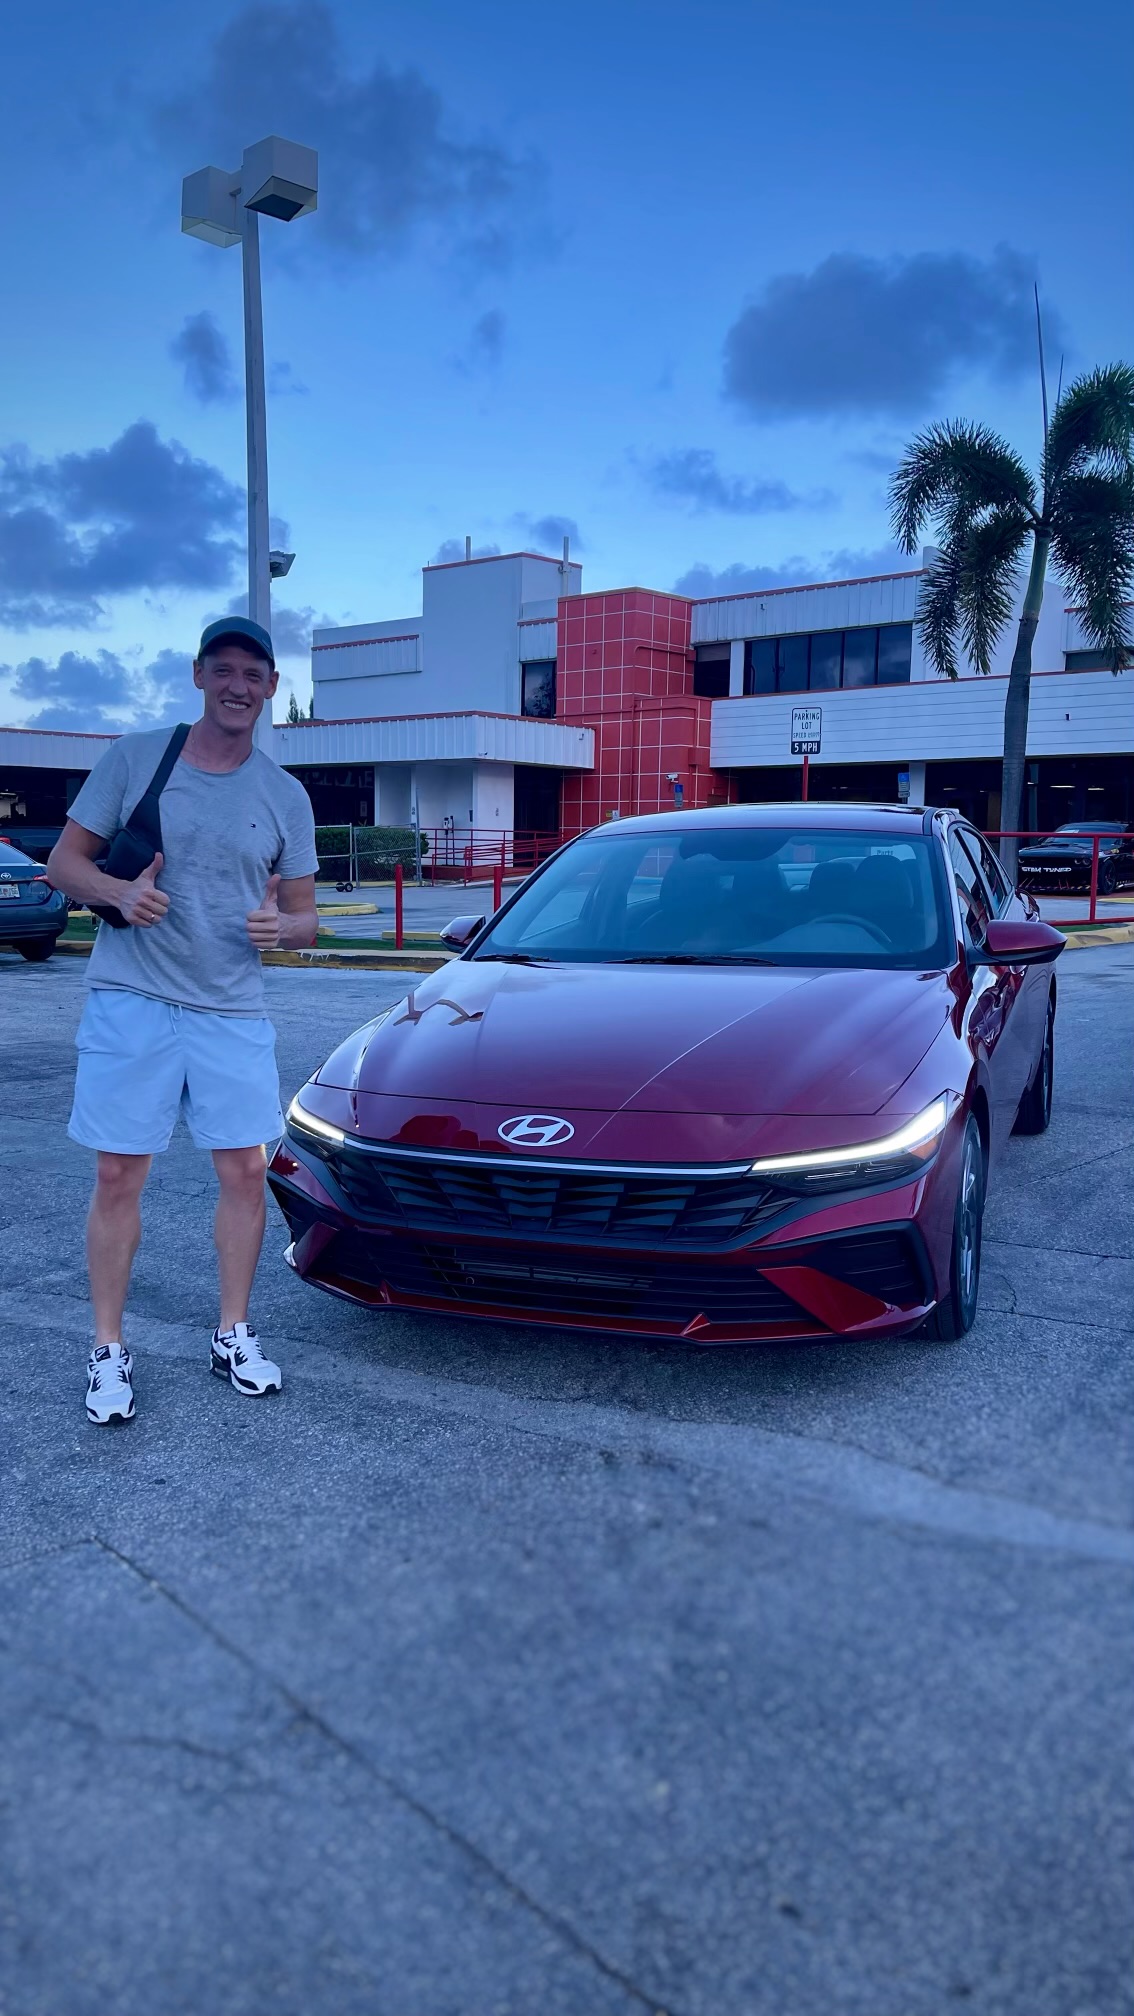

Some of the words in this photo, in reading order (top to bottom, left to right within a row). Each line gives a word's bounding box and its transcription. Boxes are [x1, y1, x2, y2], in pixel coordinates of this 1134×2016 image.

[794, 712, 820, 720] PARKING
[801, 722, 812, 730] LOT
[794, 742, 800, 753] 5
[801, 742, 818, 753] MPH
